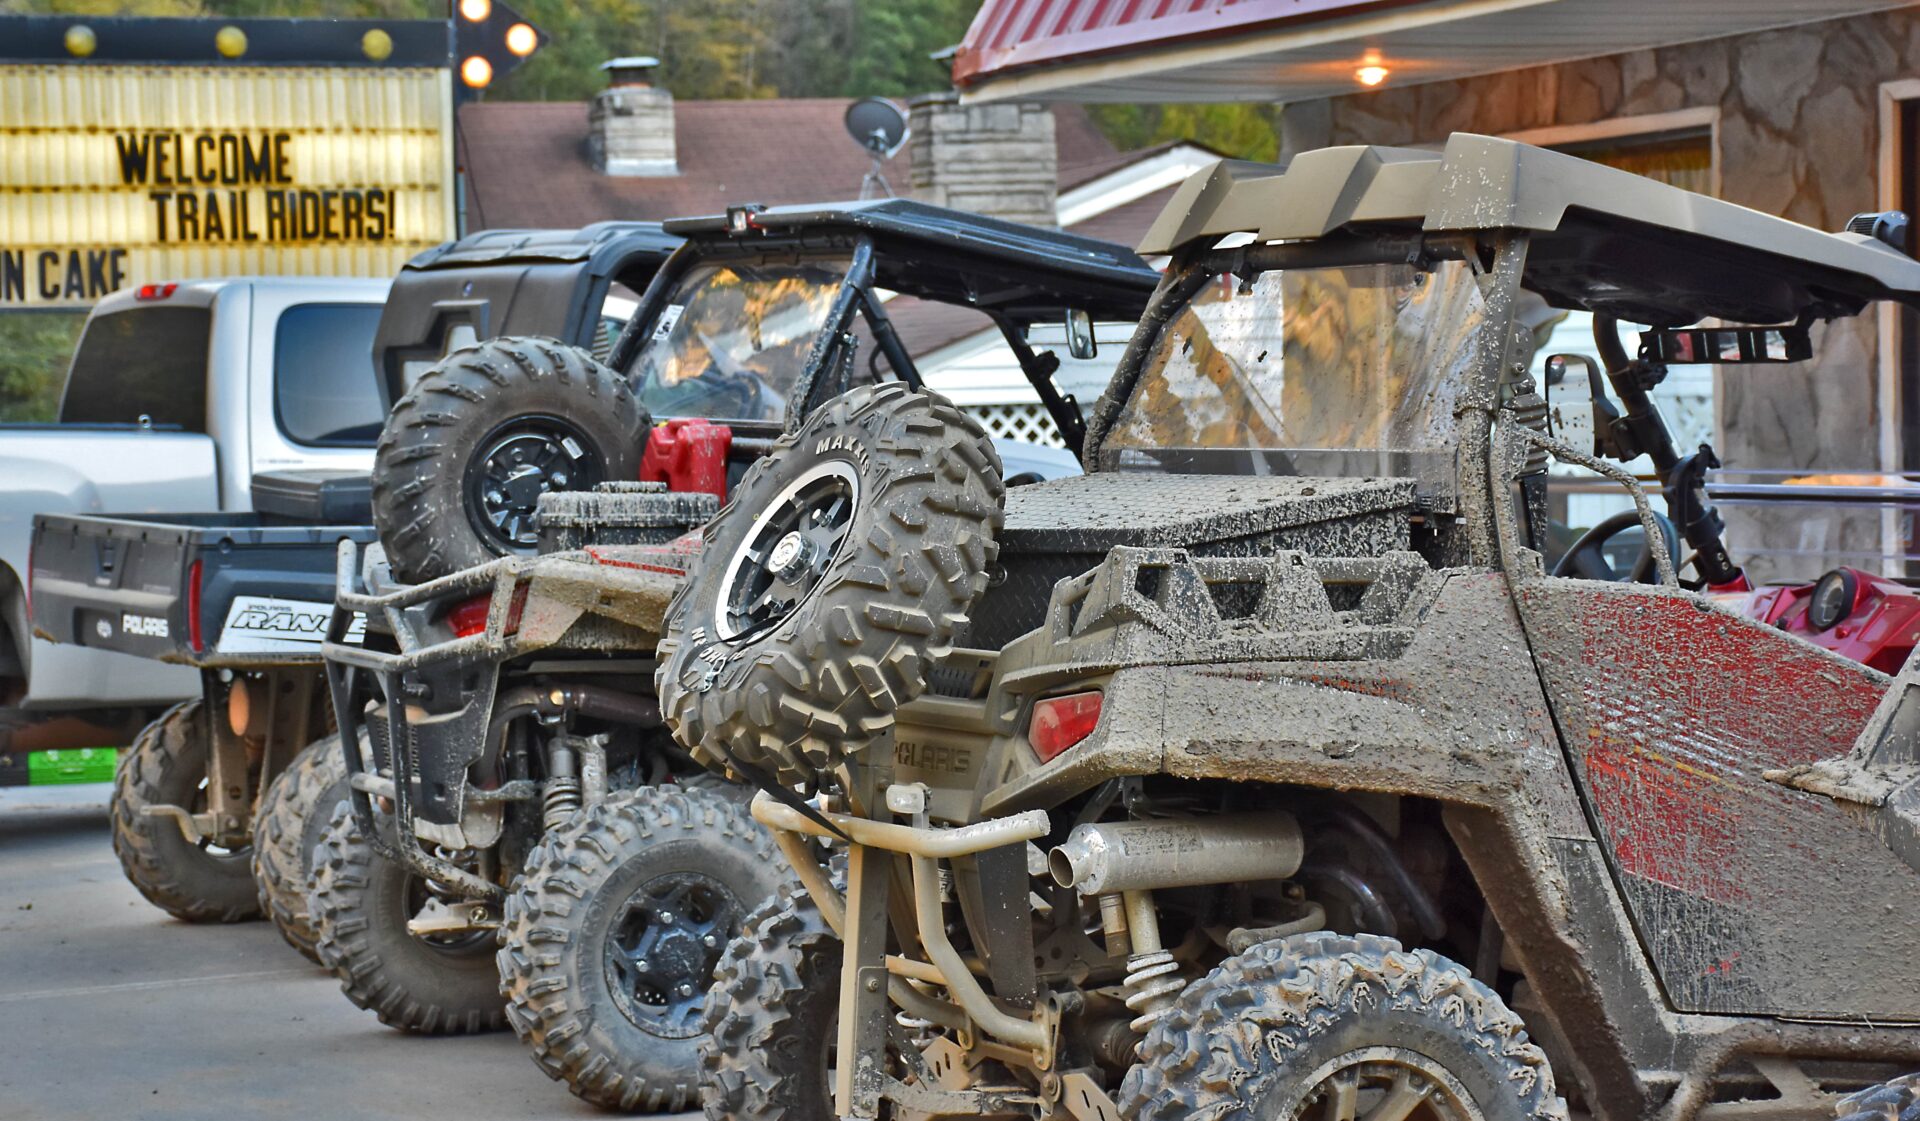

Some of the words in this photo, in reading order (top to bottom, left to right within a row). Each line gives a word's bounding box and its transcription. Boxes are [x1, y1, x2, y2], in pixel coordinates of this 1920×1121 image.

[116, 134, 292, 185] WELCOME
[149, 190, 258, 242] TRAIL
[265, 189, 396, 242] RIDERS!
[0, 249, 25, 302] N
[815, 434, 870, 477] MAXXIS
[122, 613, 169, 638] POLARIS
[248, 604, 292, 612] POLARIS
[894, 741, 970, 773] OLARIS
